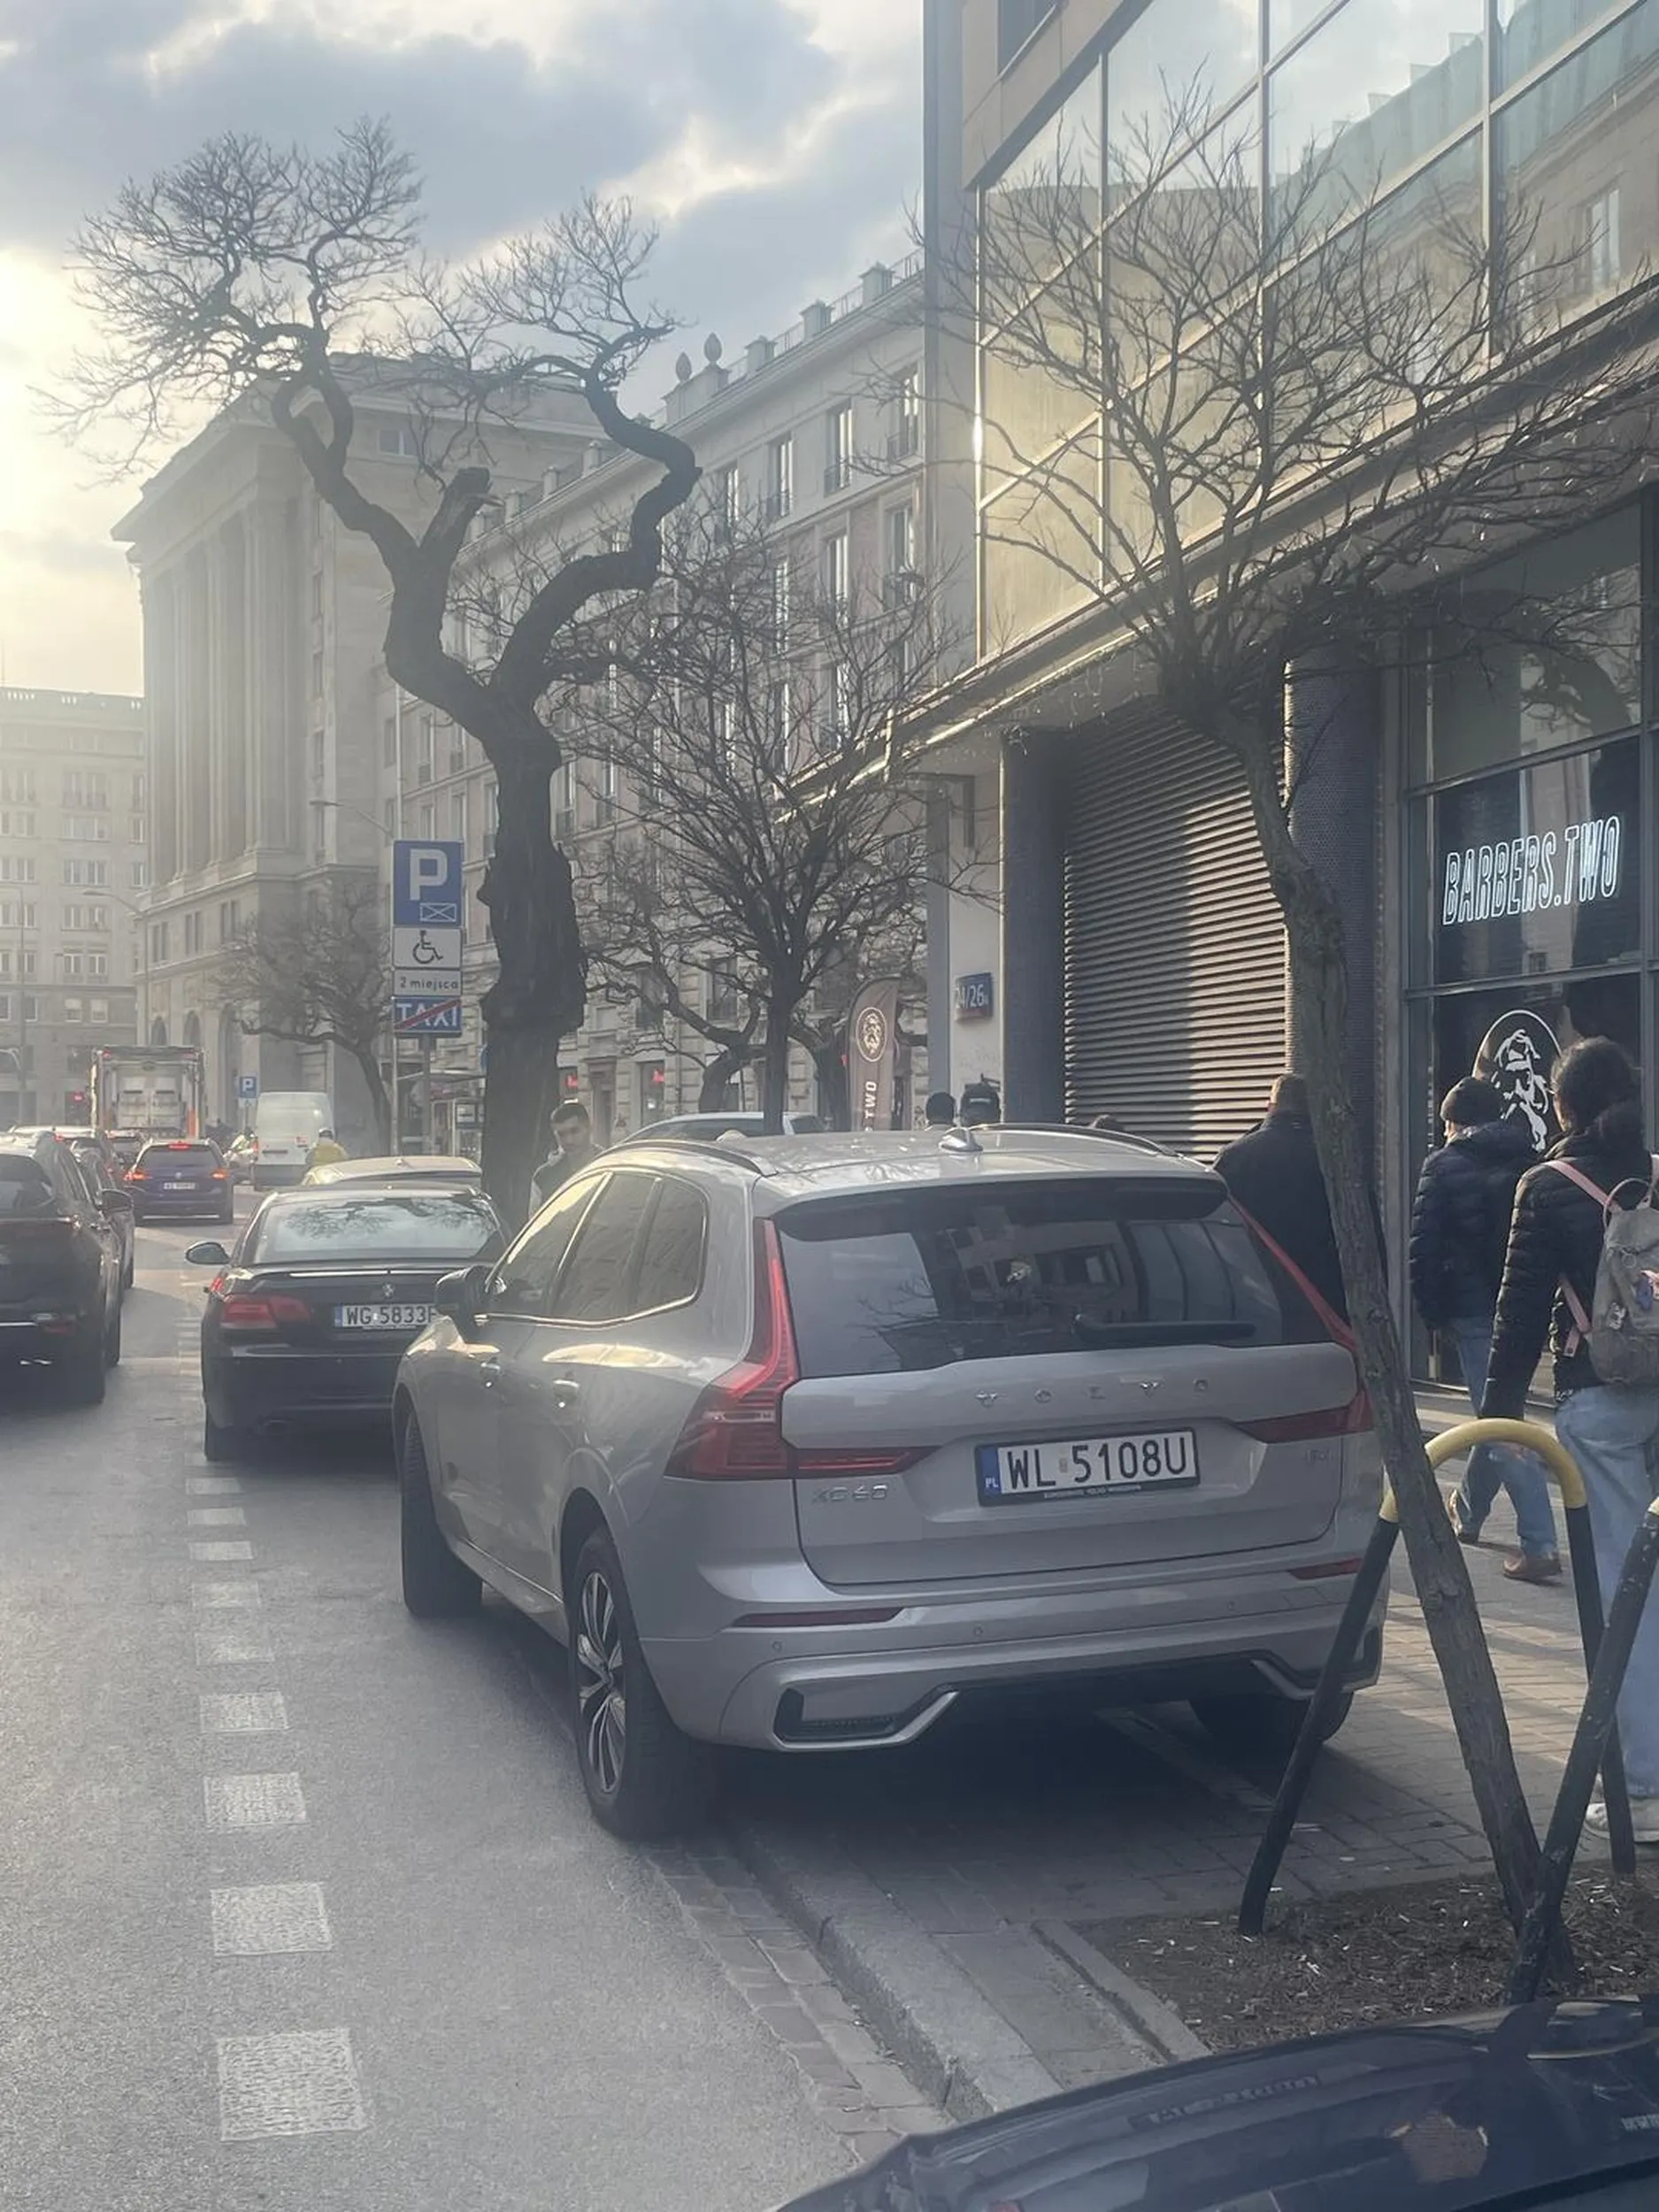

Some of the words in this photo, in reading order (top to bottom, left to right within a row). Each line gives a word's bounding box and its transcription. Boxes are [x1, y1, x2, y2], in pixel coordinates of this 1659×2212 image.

[410, 848, 448, 901] P
[1441, 816, 1620, 925] BARBERS.TWO
[400, 976, 406, 988] 2
[410, 979, 458, 991] miejsca
[396, 1003, 457, 1026] TAXI
[242, 1078, 255, 1094] P
[864, 1080, 877, 1119] TWO
[346, 1307, 372, 1325] WG
[976, 1378, 1209, 1408] VOLVO
[1007, 1448, 1056, 1489] WL
[1071, 1437, 1187, 1484] 5108U
[985, 1476, 999, 1489] PL
